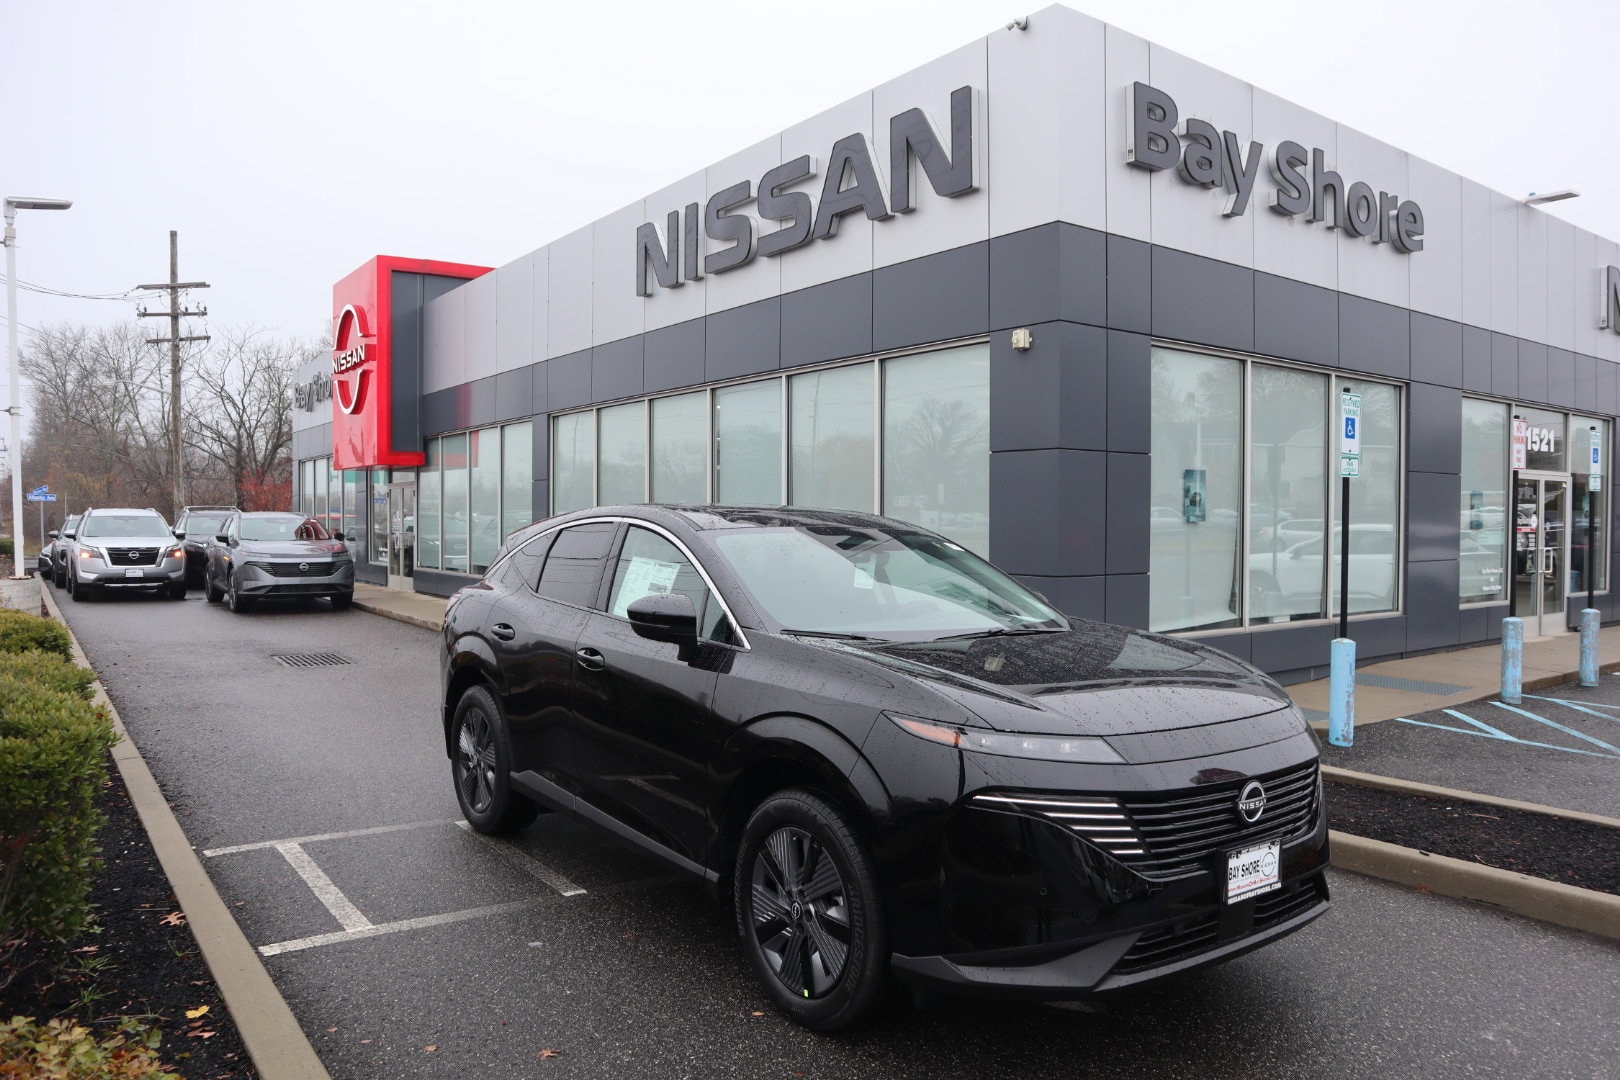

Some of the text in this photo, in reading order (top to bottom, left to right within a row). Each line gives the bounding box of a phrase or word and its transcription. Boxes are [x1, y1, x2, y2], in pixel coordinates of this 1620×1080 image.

[1126, 81, 1425, 253] Bay Shore
[636, 85, 979, 298] NISSAN
[332, 343, 366, 374] NISSAN
[294, 382, 313, 412] Bay
[1526, 426, 1555, 453] 1521
[1239, 796, 1267, 811] NISSAN
[1228, 860, 1260, 881] BAY SHORE
